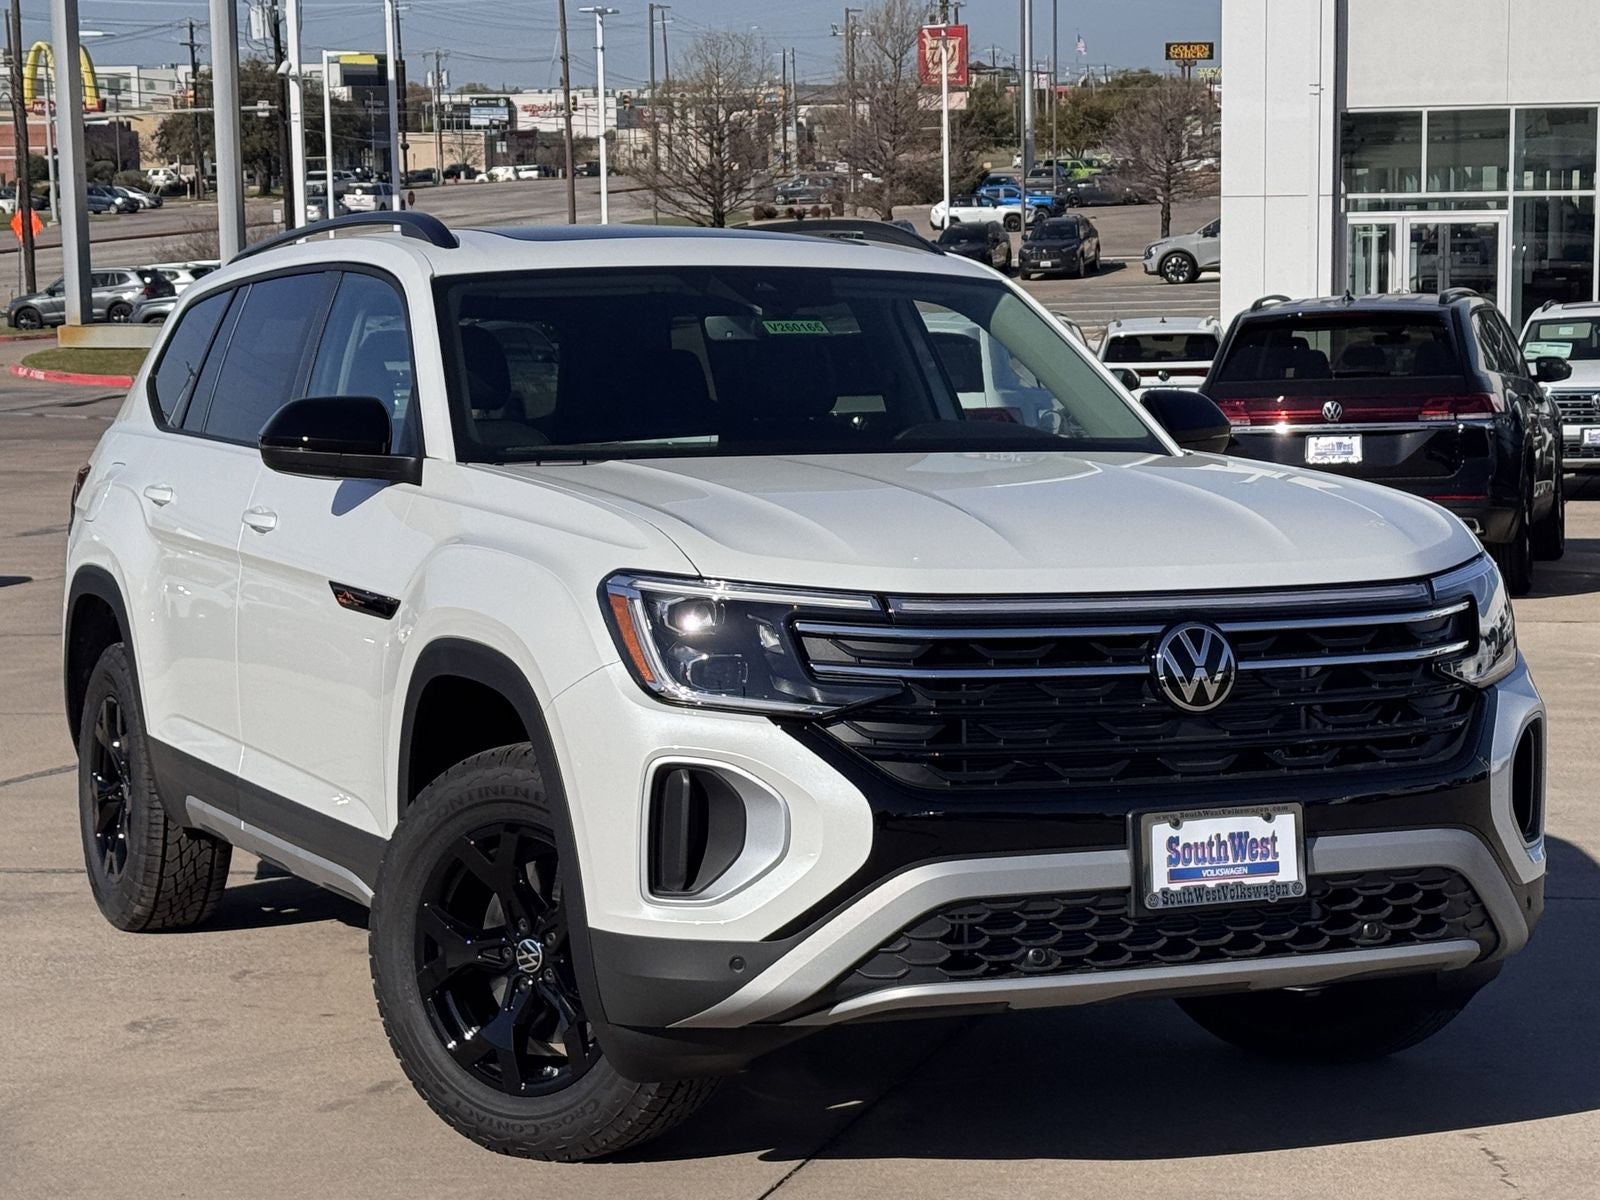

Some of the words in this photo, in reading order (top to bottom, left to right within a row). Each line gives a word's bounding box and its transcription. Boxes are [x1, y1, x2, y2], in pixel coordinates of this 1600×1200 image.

[1170, 44, 1209, 52] GOLDEN
[767, 323, 824, 332] V260165
[1166, 831, 1279, 867] SouthWest
[1202, 865, 1248, 877] VOLKSWAGEN
[1162, 881, 1289, 906] SouthWestVolkswagen
